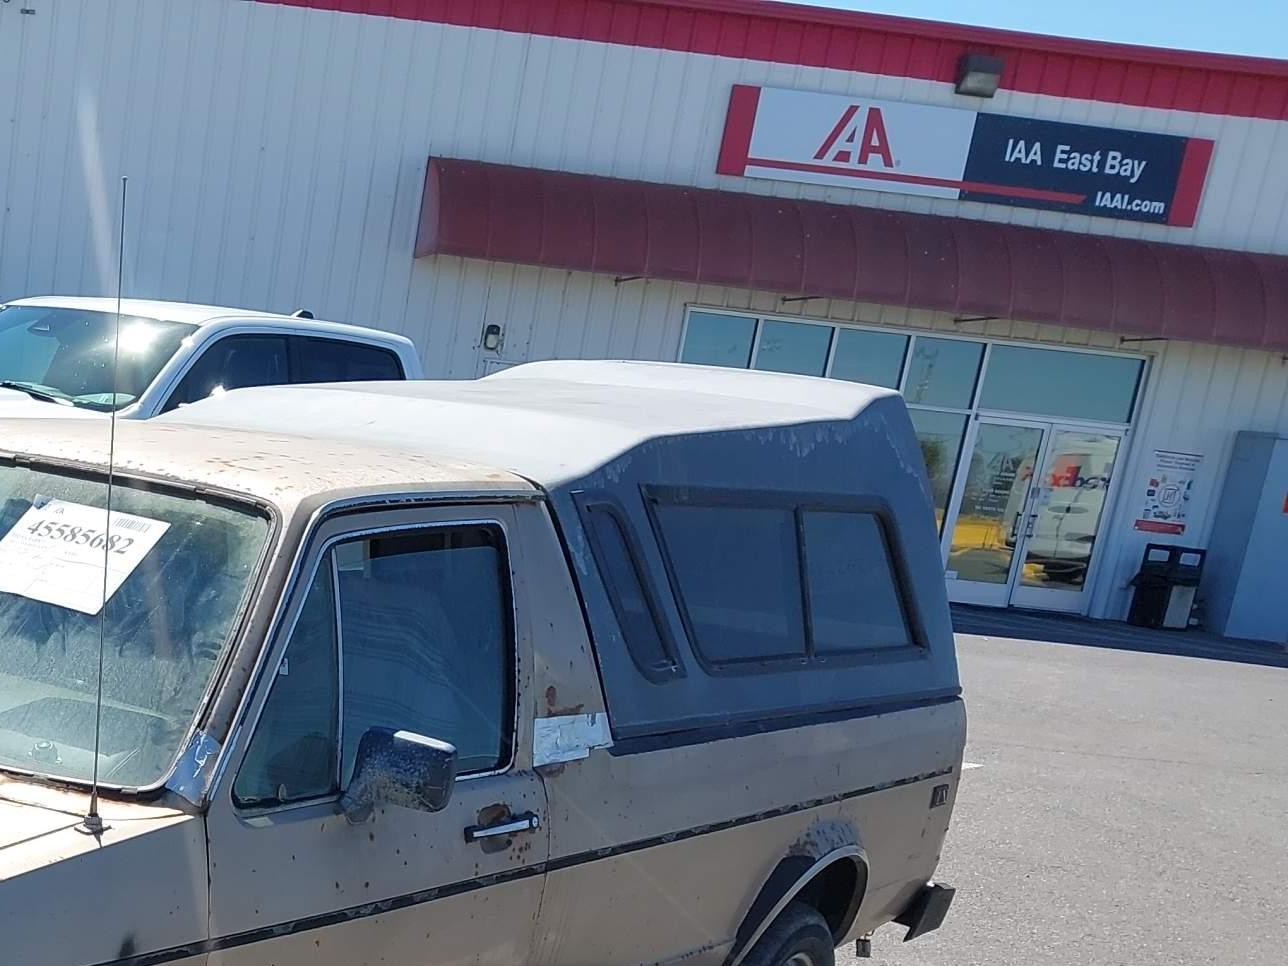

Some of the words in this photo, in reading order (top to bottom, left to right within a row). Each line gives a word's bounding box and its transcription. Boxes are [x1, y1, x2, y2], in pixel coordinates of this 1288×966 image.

[1004, 138, 1042, 166] IAA
[1053, 144, 1101, 173] East
[1104, 150, 1146, 184] Bay
[1095, 190, 1165, 214] IAAI.com
[27, 518, 135, 555] 45585682
